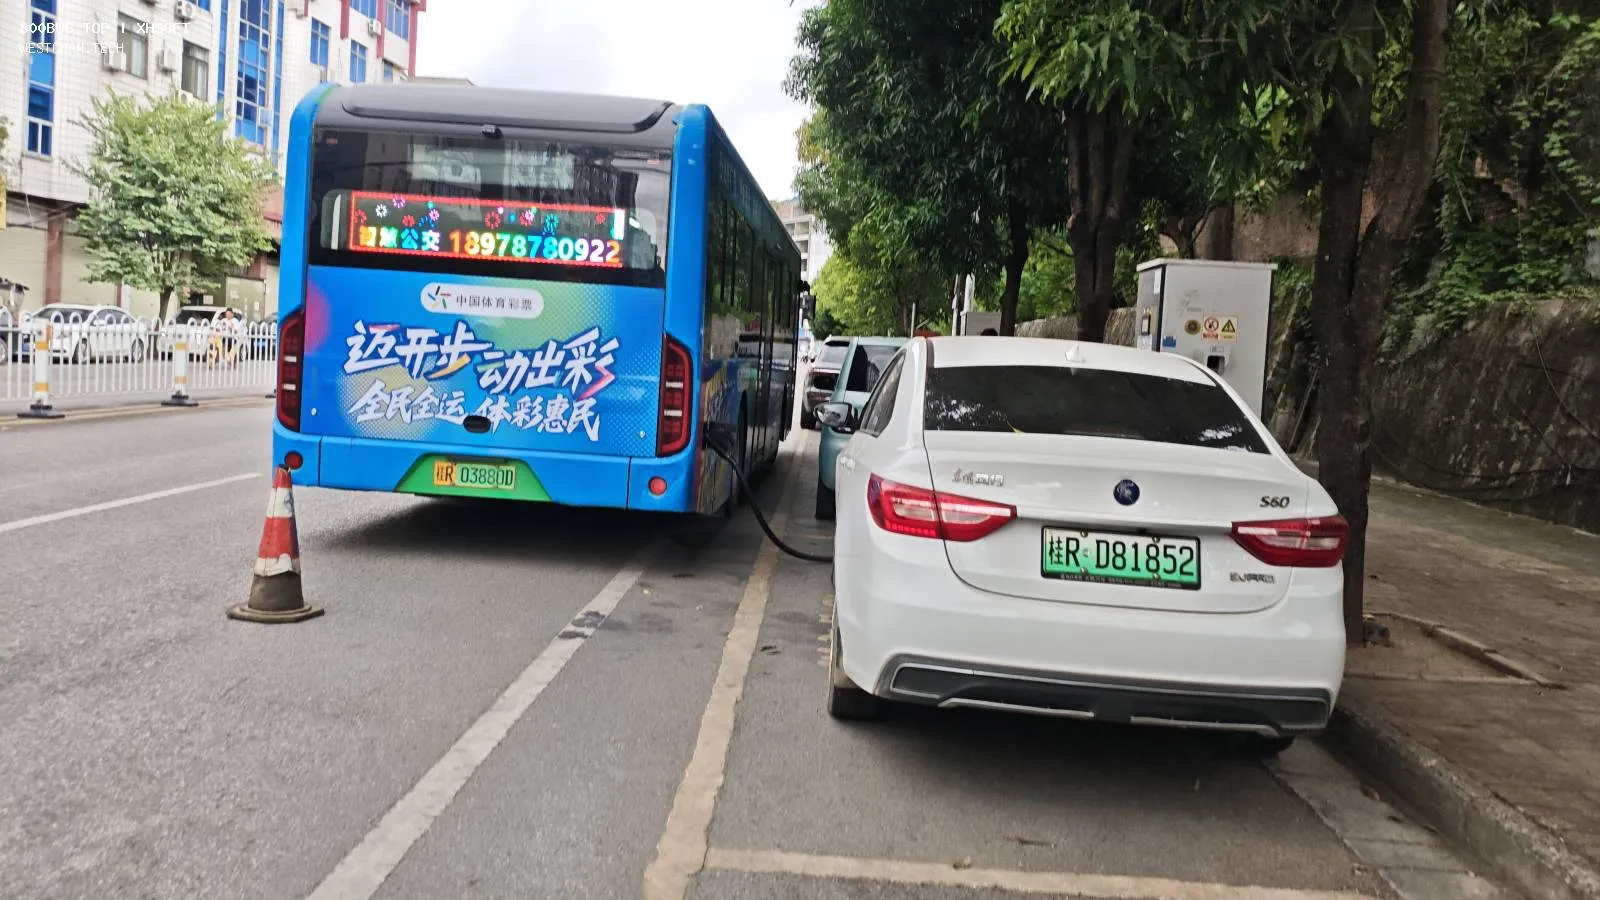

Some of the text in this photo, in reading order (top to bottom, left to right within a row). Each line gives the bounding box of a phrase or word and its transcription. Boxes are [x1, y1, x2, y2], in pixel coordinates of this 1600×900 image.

[450, 230, 620, 262] 18978780922
[456, 293, 532, 311] 中国体育彩票
[1259, 495, 1290, 509] S60
